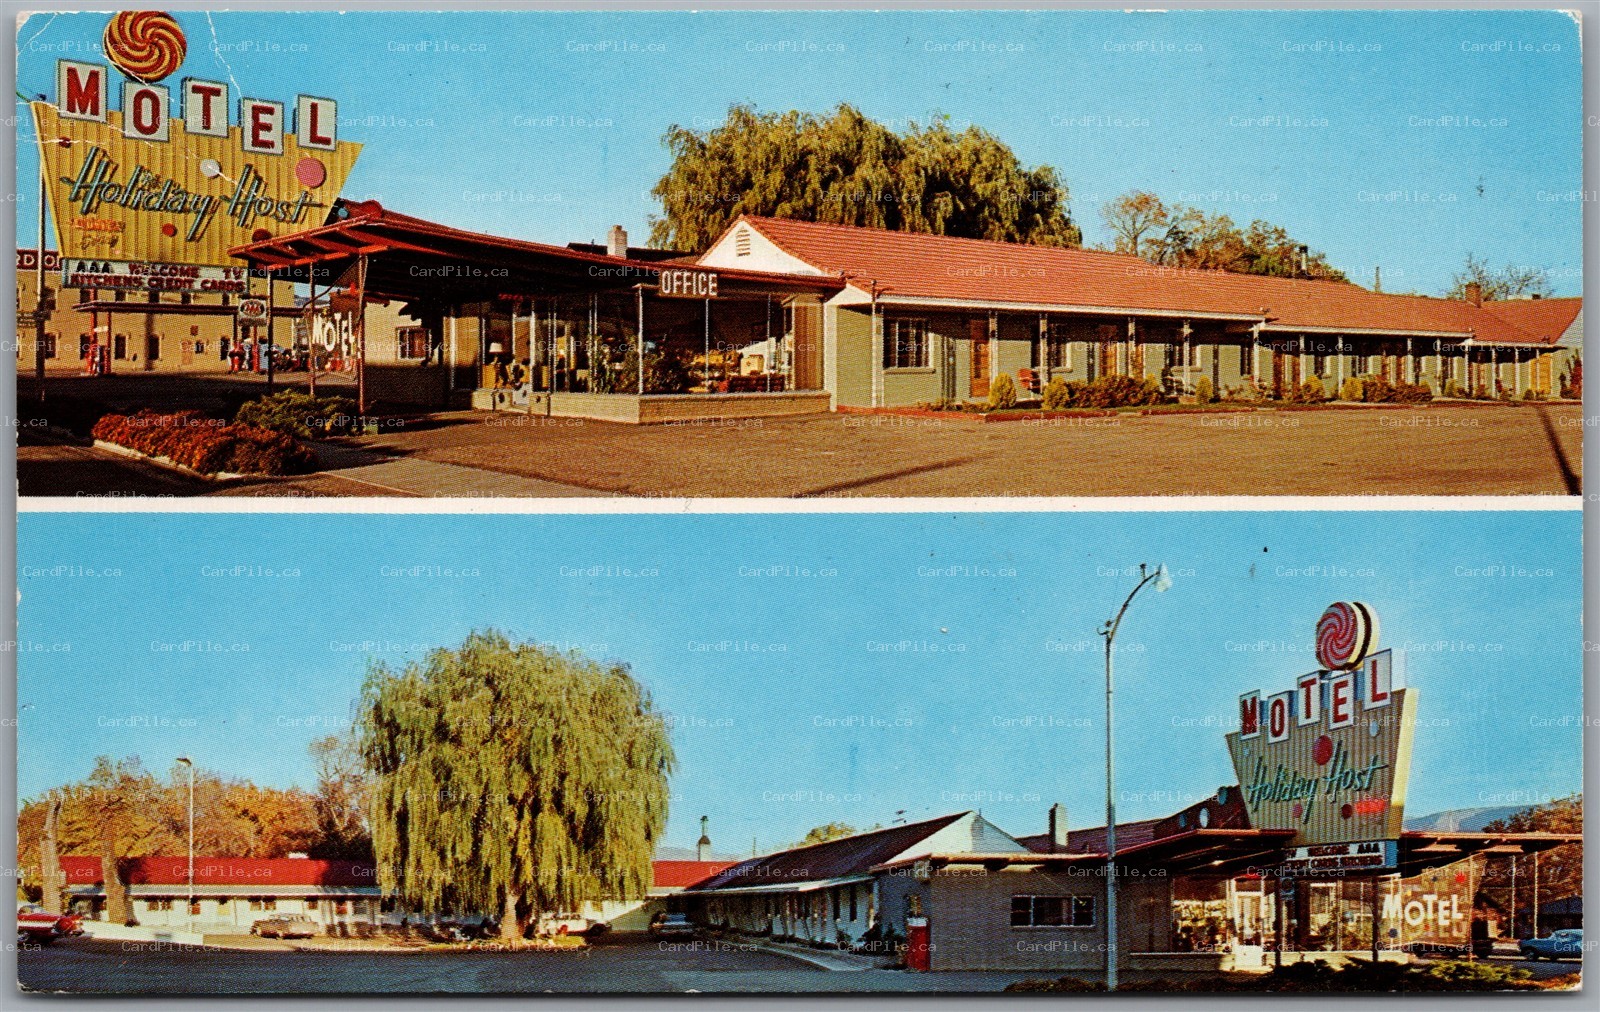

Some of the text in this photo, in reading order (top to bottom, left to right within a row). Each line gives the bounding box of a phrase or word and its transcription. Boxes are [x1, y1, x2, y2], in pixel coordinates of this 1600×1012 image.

[66, 67, 332, 149] MOTEL
[60, 147, 325, 242] Holiday Host
[70, 273, 246, 292] KITCHENS CREDIT CARDS
[76, 260, 244, 281] AAA WELCOME TV
[662, 270, 718, 296] OFFICE
[312, 311, 356, 357] MOTEL
[1242, 659, 1388, 737] MOTEL
[1247, 740, 1389, 824] Holiday Host
[1357, 842, 1380, 854] AAA
[1382, 894, 1463, 926] MOTEL
